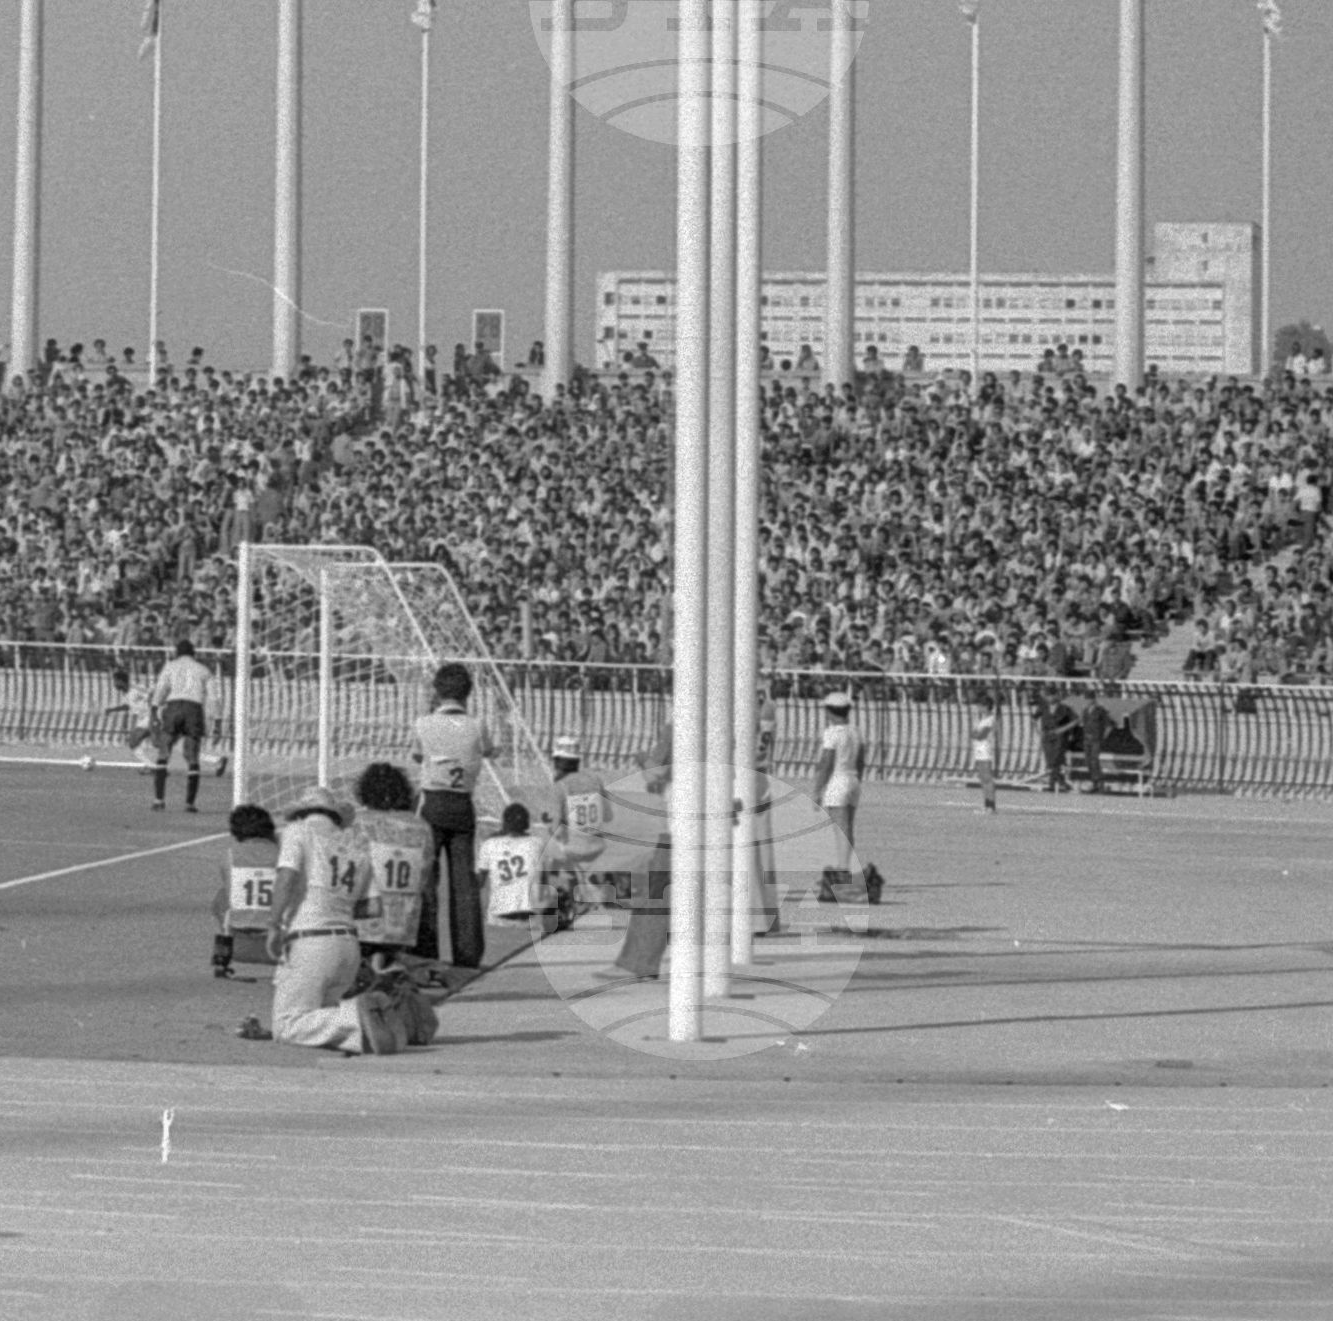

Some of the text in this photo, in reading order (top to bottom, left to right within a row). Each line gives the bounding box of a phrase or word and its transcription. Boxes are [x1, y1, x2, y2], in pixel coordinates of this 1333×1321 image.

[330, 856, 355, 893] 14
[385, 859, 411, 889] 10
[498, 855, 528, 881] 32
[244, 880, 273, 907] 15
